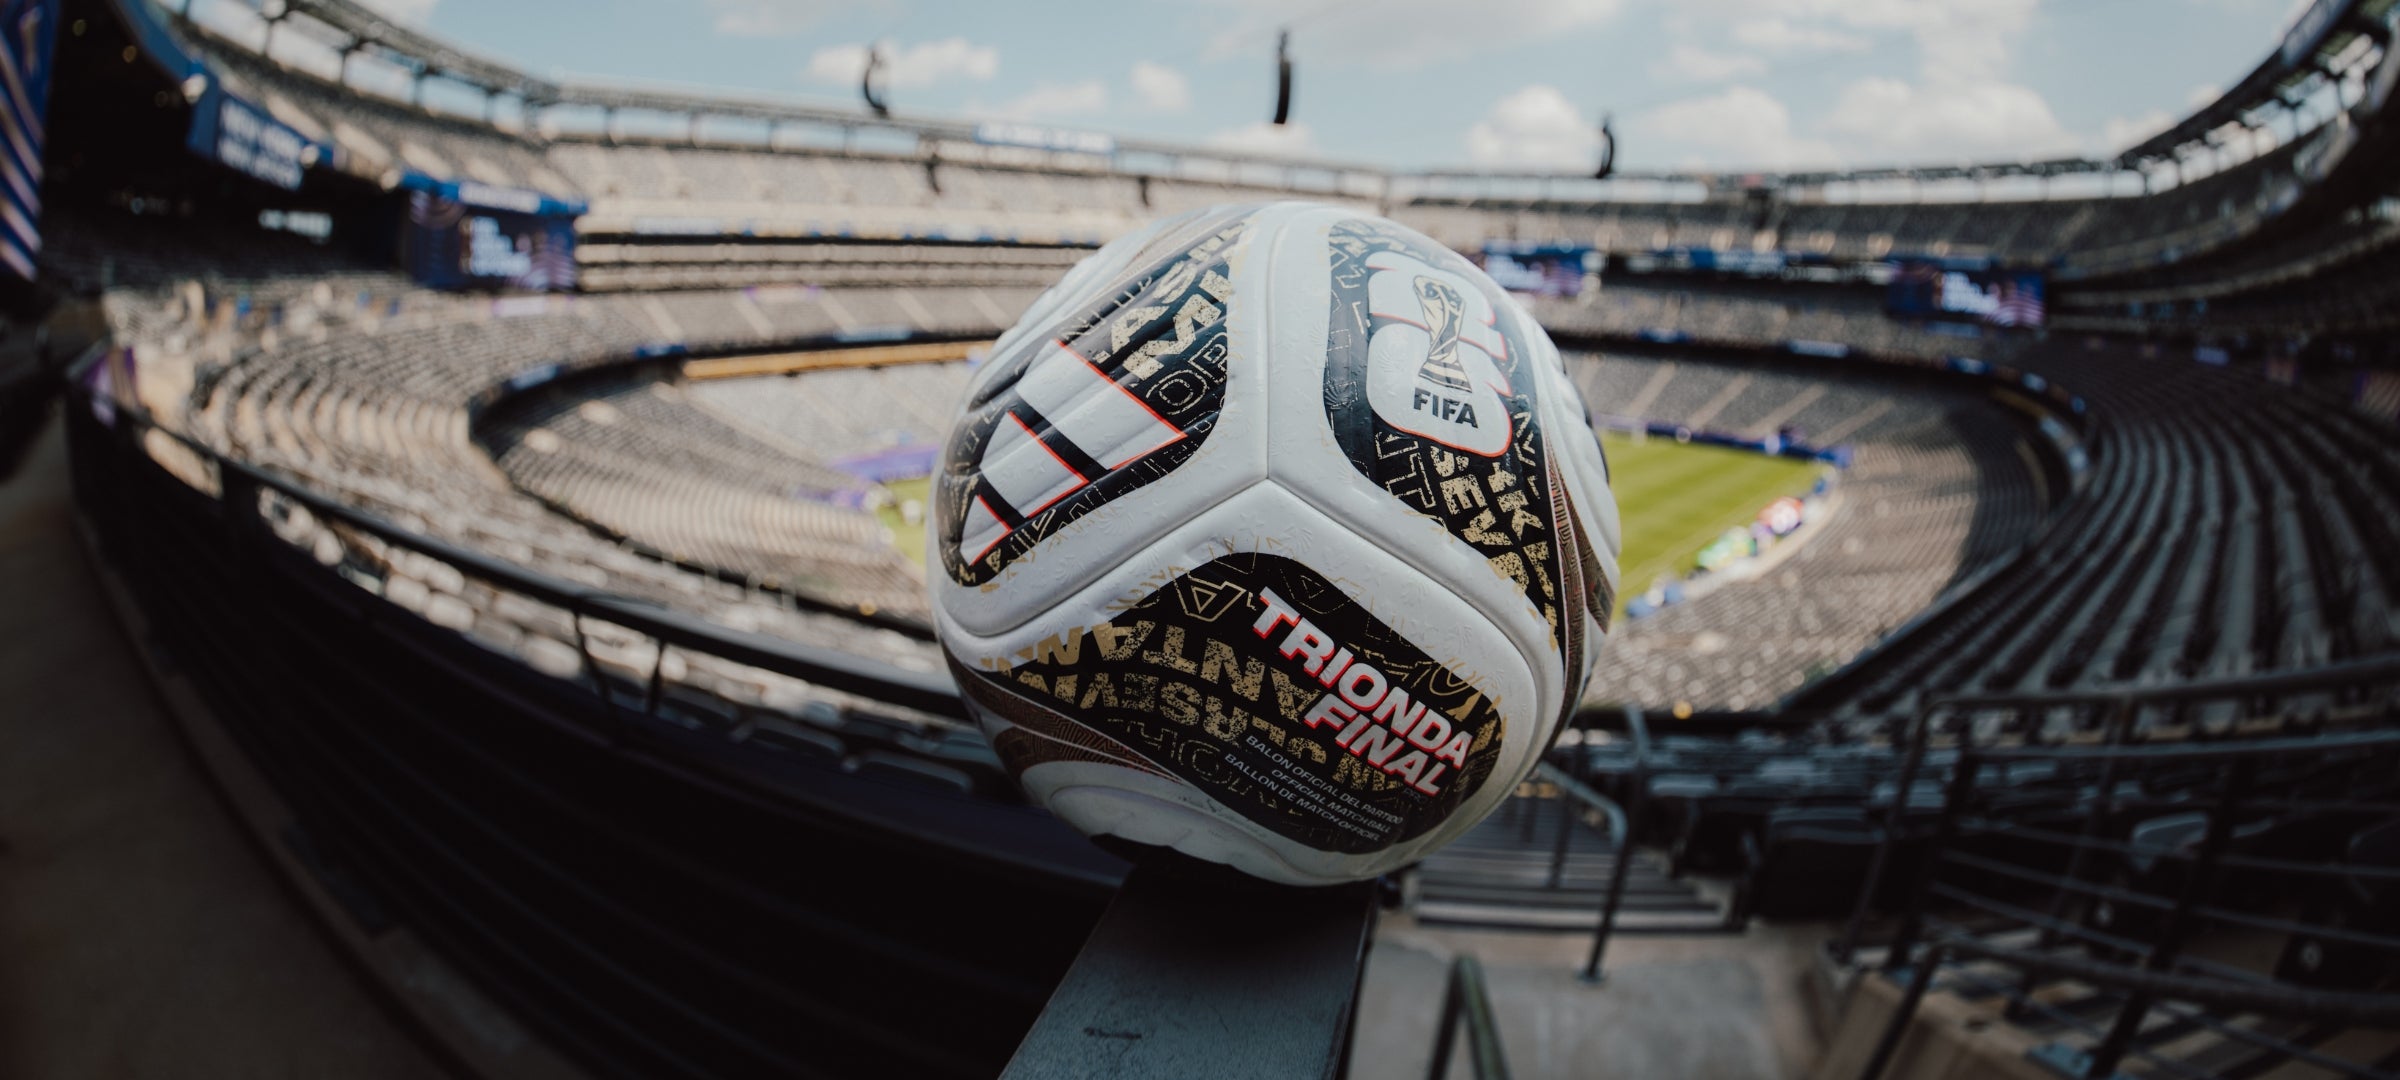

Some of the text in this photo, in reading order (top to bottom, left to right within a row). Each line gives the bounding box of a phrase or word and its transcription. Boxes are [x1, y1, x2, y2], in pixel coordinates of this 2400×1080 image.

[1413, 387, 1480, 429] FIFA
[1252, 586, 1473, 771] TRIONDA
[1246, 735, 1294, 770] BALON
[1292, 765, 1338, 797] OFICIAL
[1339, 792, 1361, 809] DEL
[1360, 803, 1404, 824] PARTIDO
[1303, 693, 1447, 796] FINAL
[1224, 753, 1381, 841] BALLON DE MATCH OFFICIEL
[1271, 769, 1327, 805] OFFICIAL
[1327, 801, 1369, 825] MATCH
[1367, 819, 1391, 834] BALL
